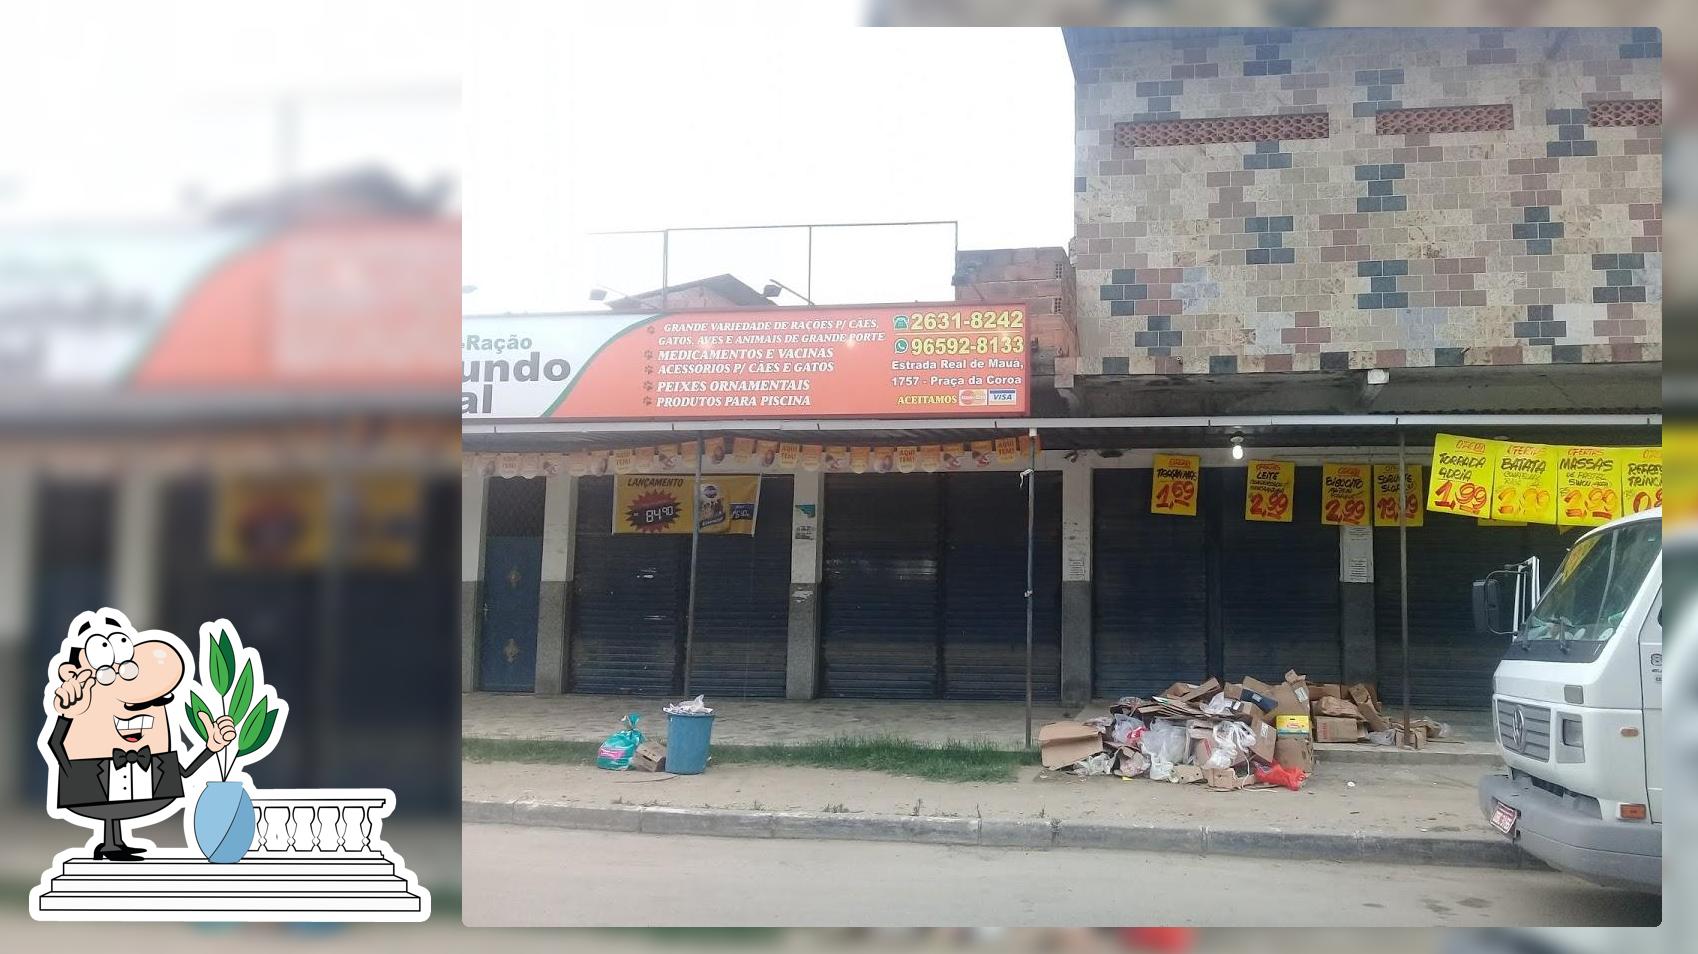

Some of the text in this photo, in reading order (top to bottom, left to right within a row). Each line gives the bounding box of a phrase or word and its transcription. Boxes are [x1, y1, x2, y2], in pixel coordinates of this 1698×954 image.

[664, 322, 708, 332] GRANDE
[711, 321, 770, 332] VARIEDADE
[773, 321, 787, 331] DE
[835, 319, 847, 330] P/
[911, 310, 1024, 330] 2631-8242
[698, 335, 723, 345] AVES
[725, 335, 733, 344] E
[736, 334, 782, 344] ANIMAIS
[784, 334, 798, 343] DE
[801, 333, 847, 343] GRANDE
[848, 332, 886, 343] PORTE
[911, 335, 1024, 355] 96592-8133
[658, 348, 834, 361] MEDICAMENTOS E VACINAS
[733, 362, 746, 374] P/
[749, 361, 781, 373] CÃES
[782, 362, 791, 373] E
[794, 361, 834, 373] GATOS
[891, 360, 937, 370] Estrada
[940, 359, 967, 369] Real
[970, 359, 985, 369] de
[657, 380, 810, 392] PEIXES ORNAMENTAIS
[891, 376, 920, 386] 1757
[930, 376, 965, 388] Praça
[968, 376, 983, 385] da
[986, 375, 1022, 385] Coroa
[656, 395, 811, 408] PRODUTOS PARA PISCINA
[897, 395, 957, 405] ACEITAMOS
[1439, 453, 1486, 468] TORRADA
[1501, 458, 1547, 474] BATATA
[1560, 457, 1614, 472] MASSAS
[627, 477, 684, 488] LANÇAMENTO
[1256, 471, 1280, 481] LEITE
[1435, 480, 1487, 513] 1,99
